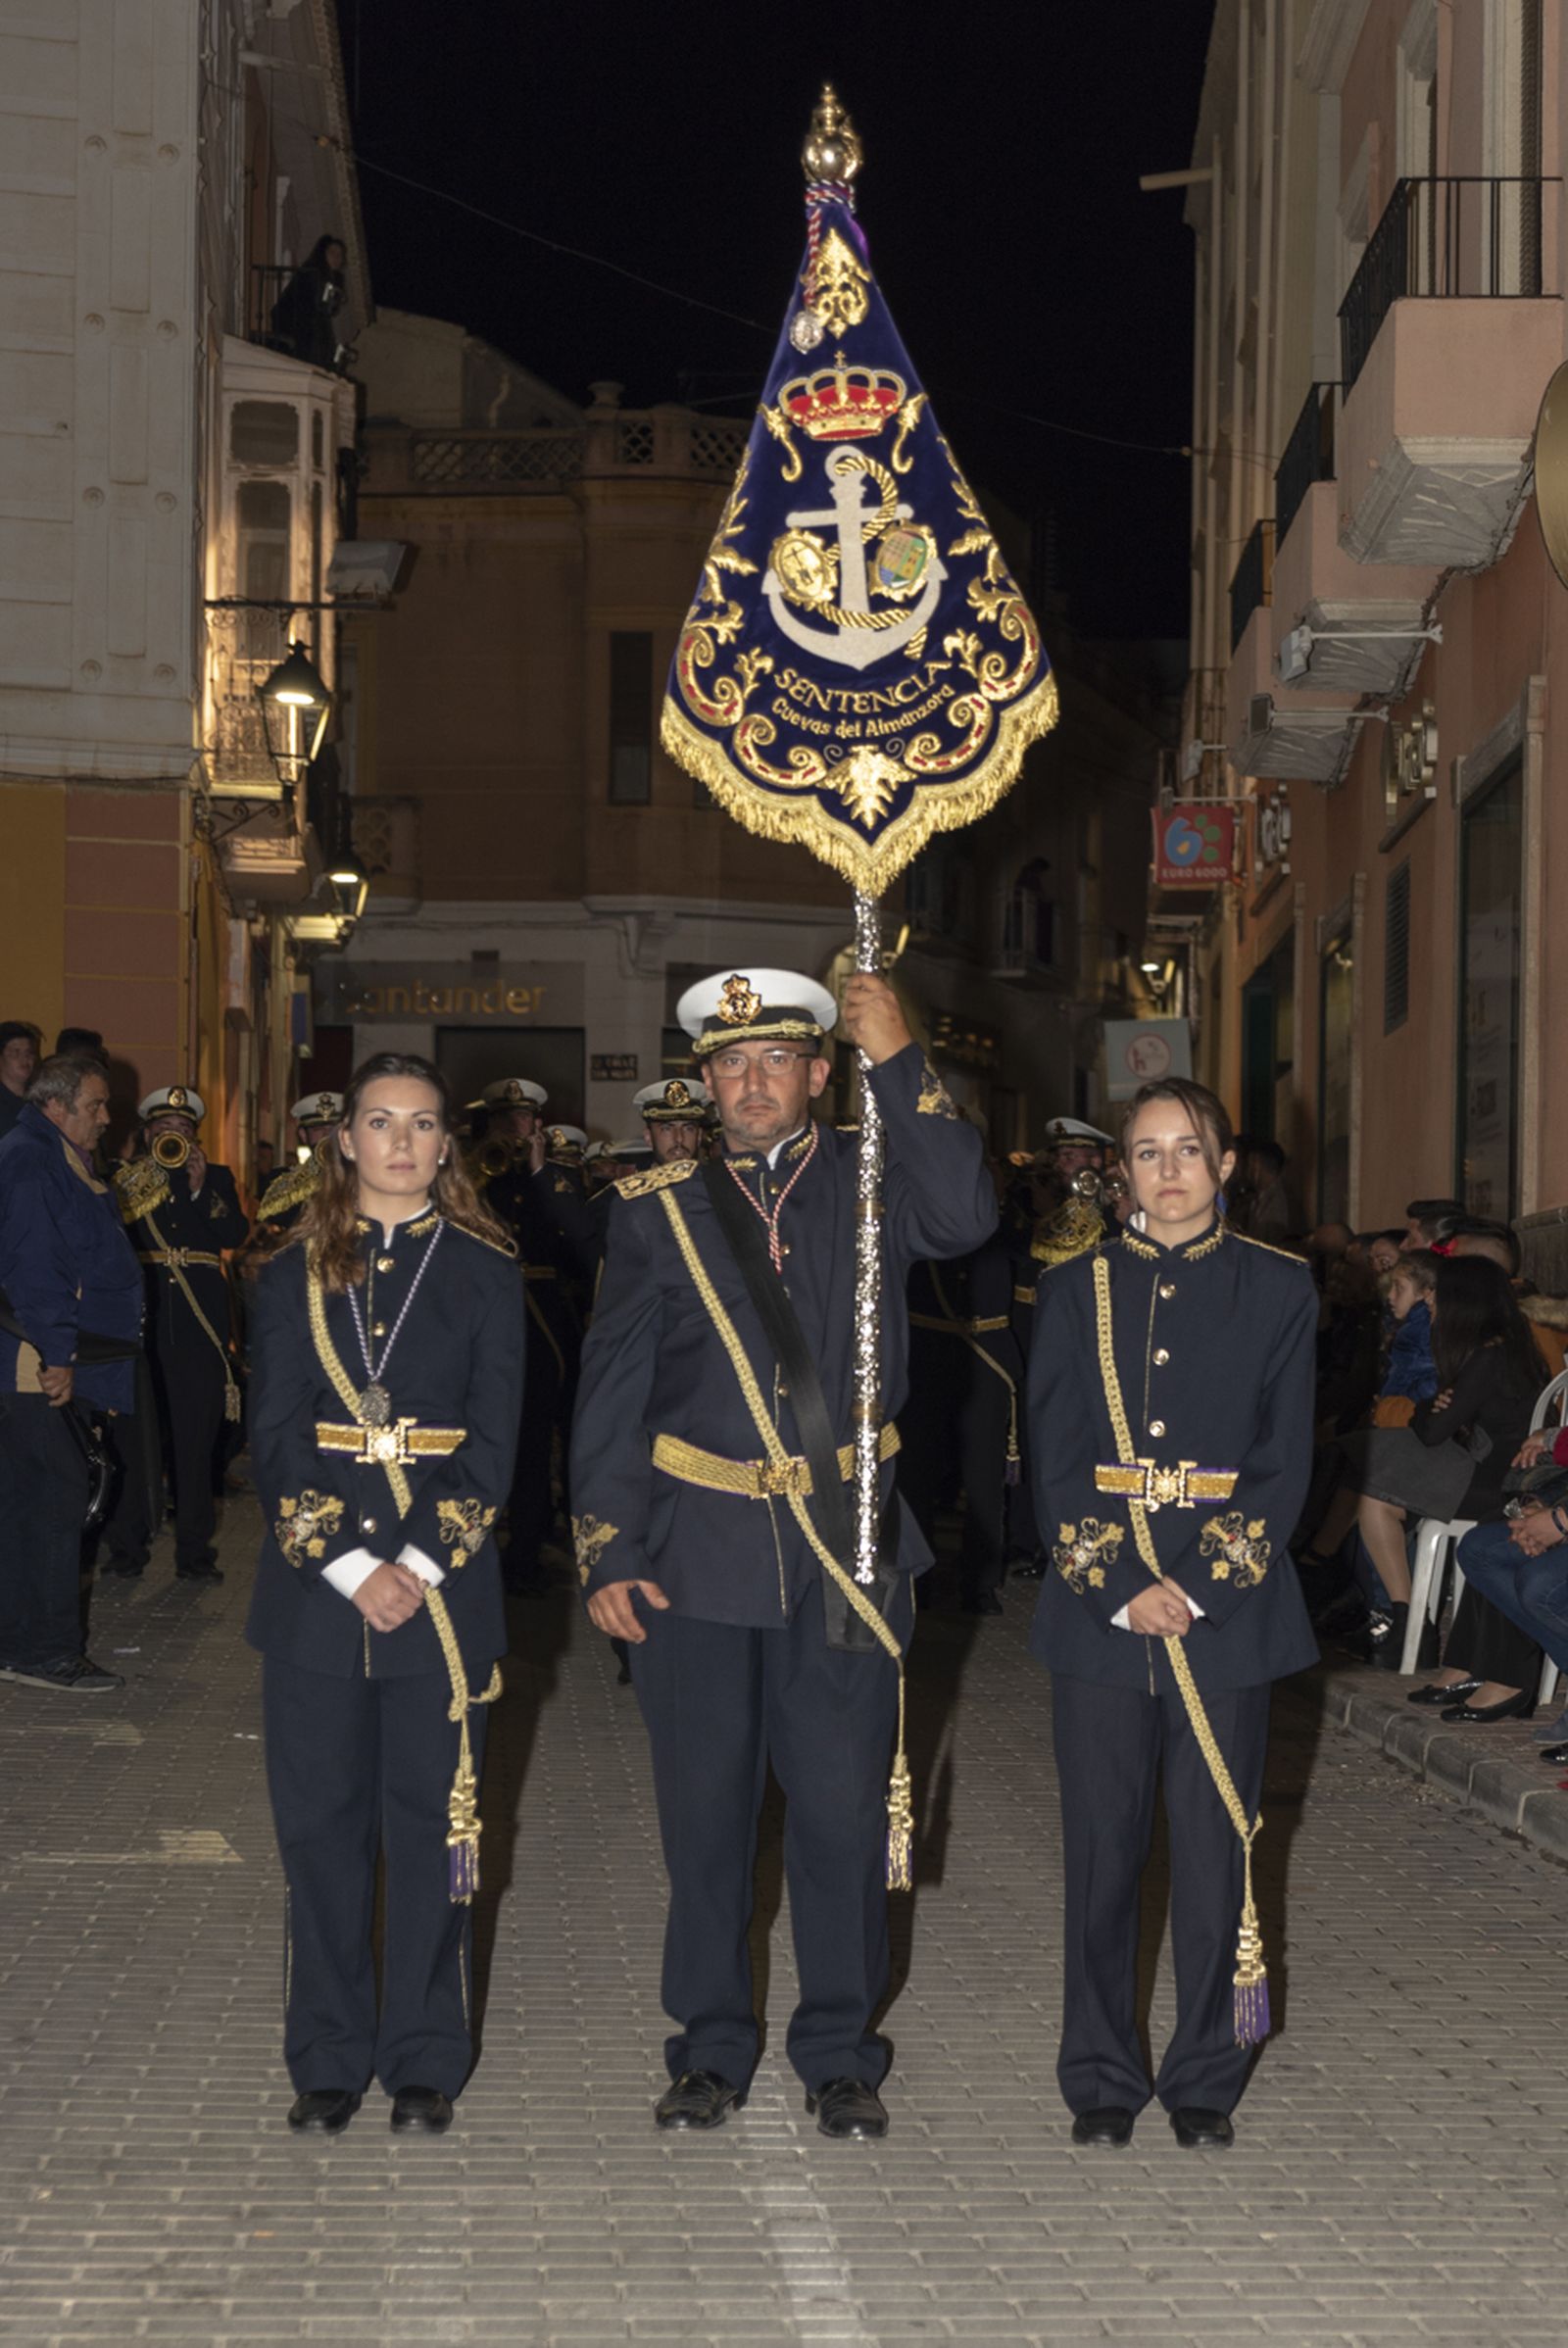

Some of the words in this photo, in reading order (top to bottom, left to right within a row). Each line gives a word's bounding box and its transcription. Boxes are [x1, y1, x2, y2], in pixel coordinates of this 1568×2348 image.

[771, 697, 832, 736] Cuevas
[835, 719, 861, 739] del
[865, 684, 956, 738] Almanzora
[774, 660, 953, 713] SENTENCIA
[1161, 867, 1193, 878] EURO
[1195, 866, 1227, 878] 6000
